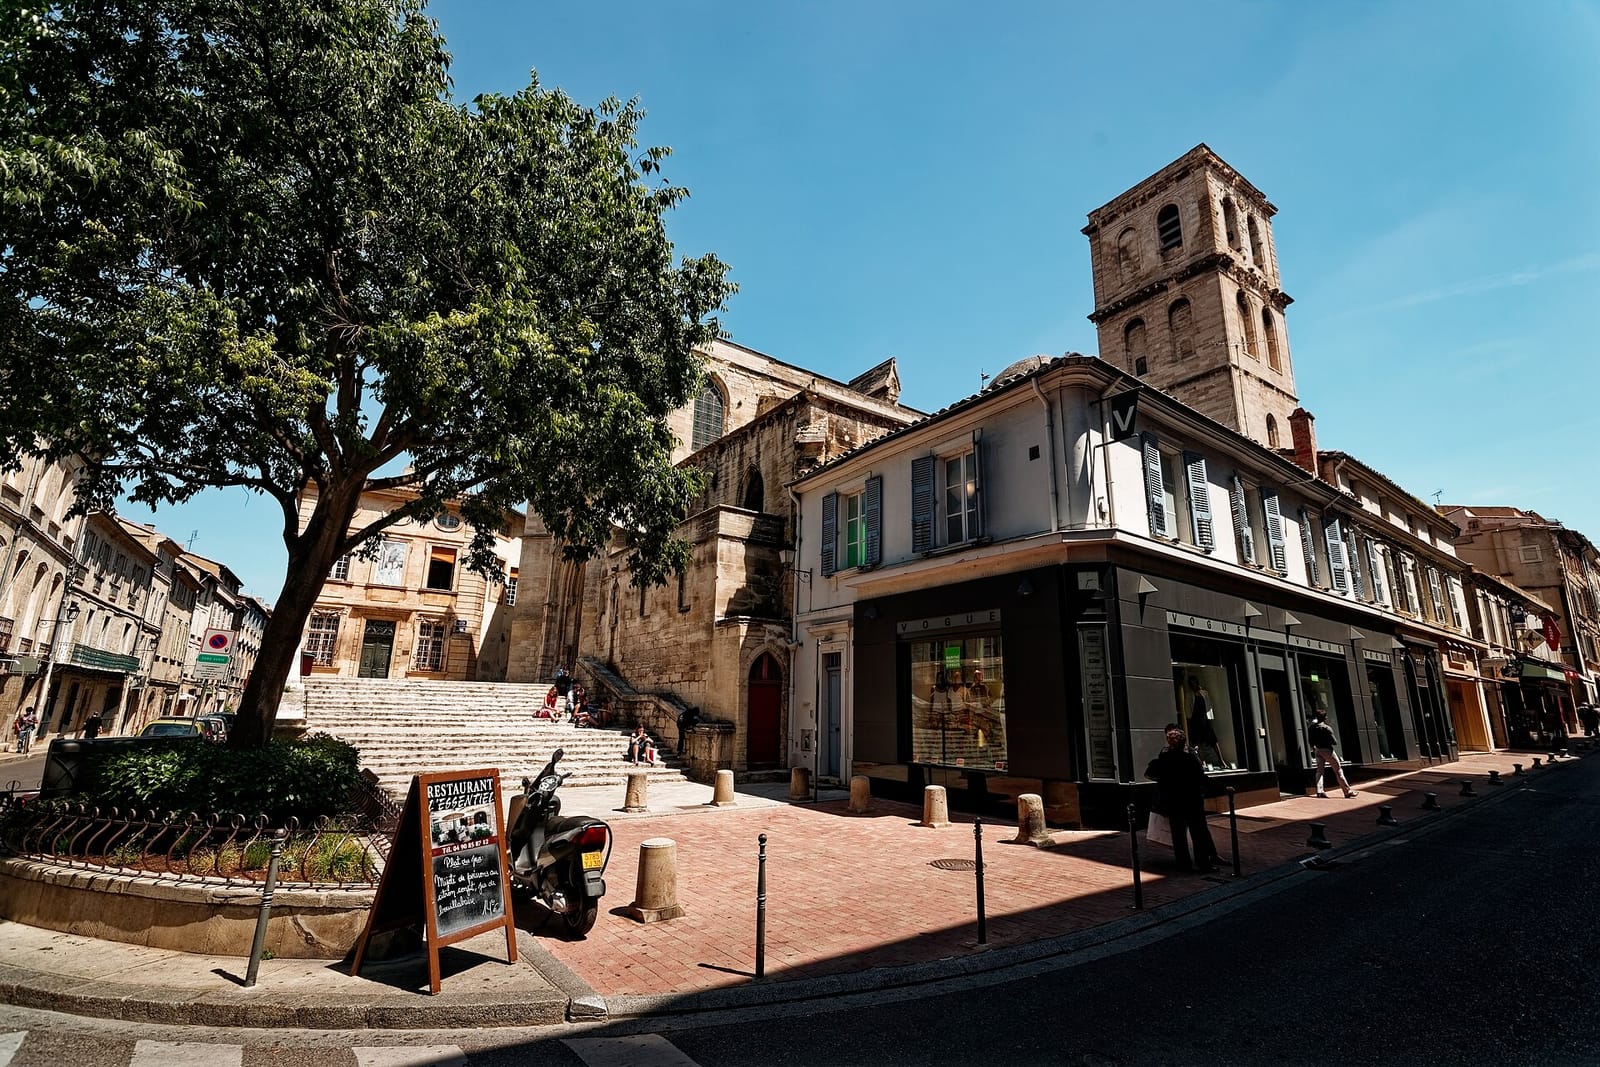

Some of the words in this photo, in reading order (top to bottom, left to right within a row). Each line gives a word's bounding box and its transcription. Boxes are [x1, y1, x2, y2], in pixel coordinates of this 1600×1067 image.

[1113, 405, 1135, 432] V
[901, 611, 996, 632] VOGUE
[1172, 614, 1241, 635] VOGUE
[427, 778, 494, 799] RESTAURANT
[428, 791, 495, 813] L'ESSENTIEL
